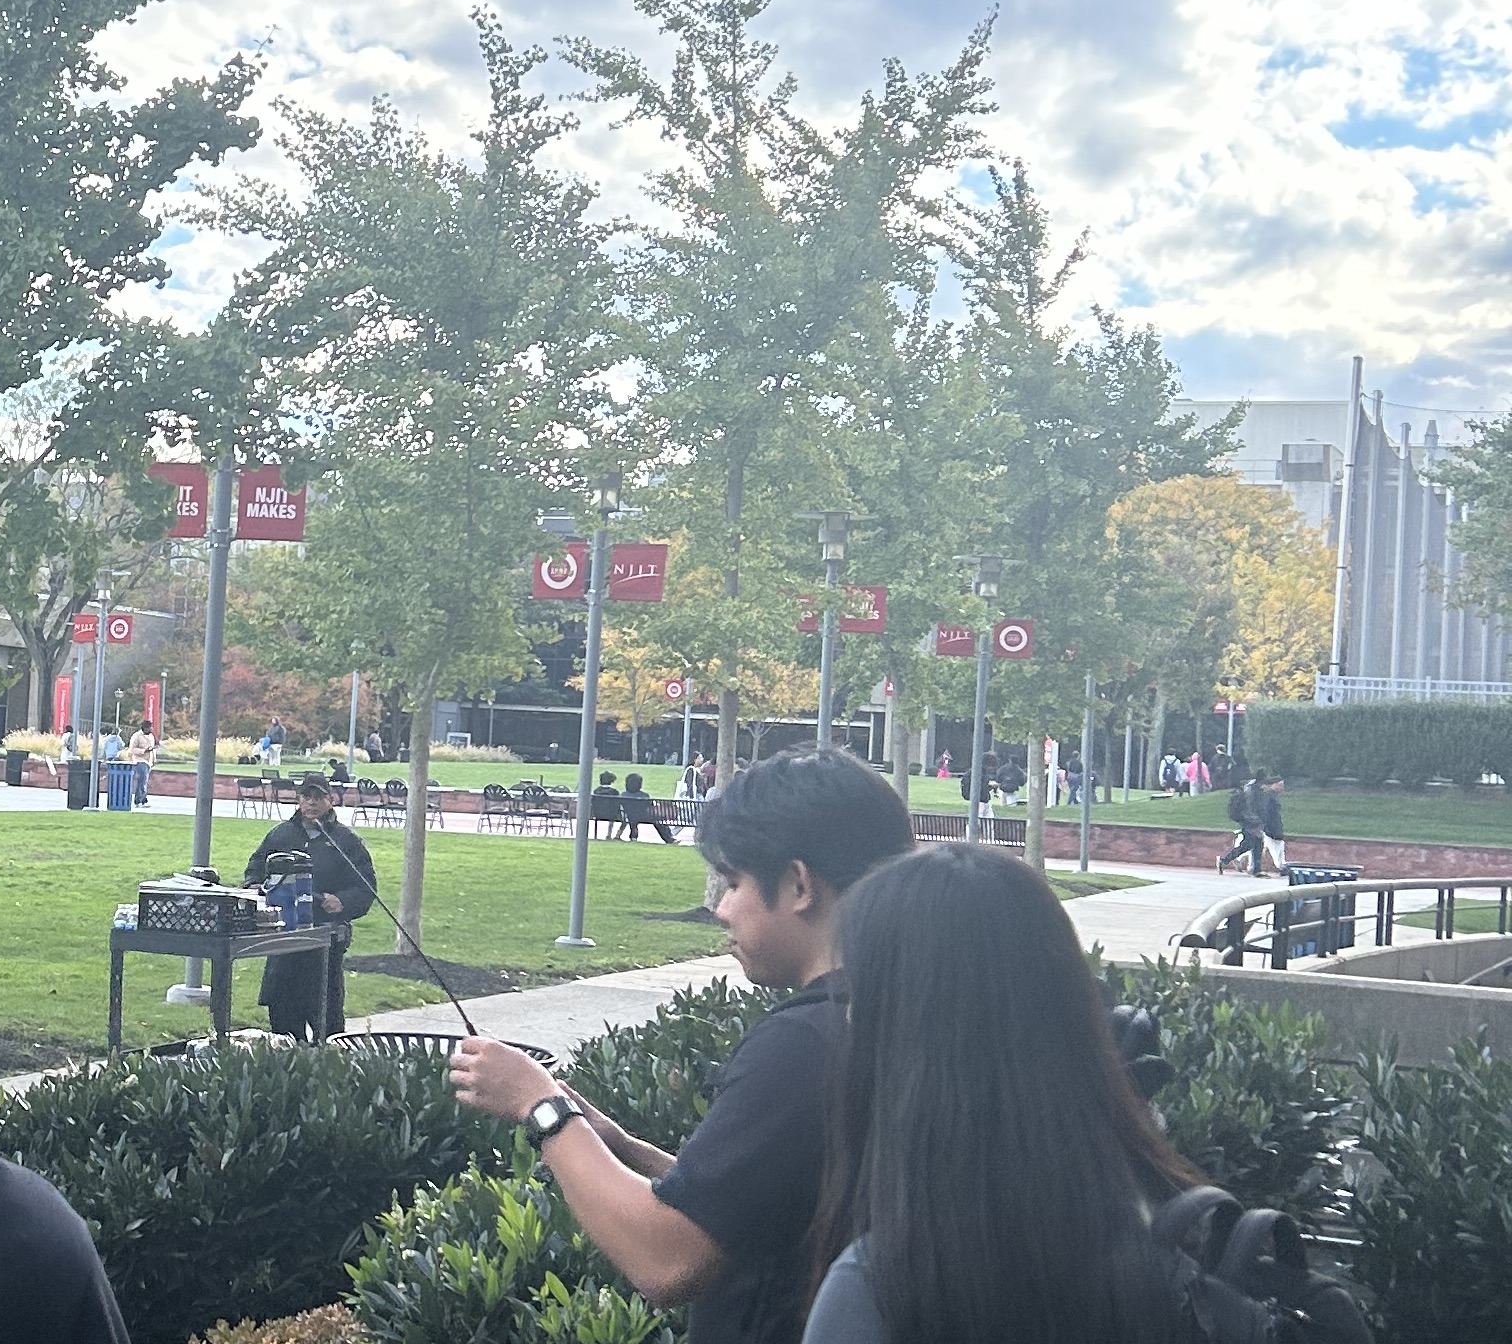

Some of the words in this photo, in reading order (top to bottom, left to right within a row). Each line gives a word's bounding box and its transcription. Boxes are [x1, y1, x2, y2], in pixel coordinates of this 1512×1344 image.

[178, 485, 194, 502] IT
[246, 502, 297, 520] MAKES
[613, 564, 658, 577] NJIT
[939, 630, 970, 639] NJIT
